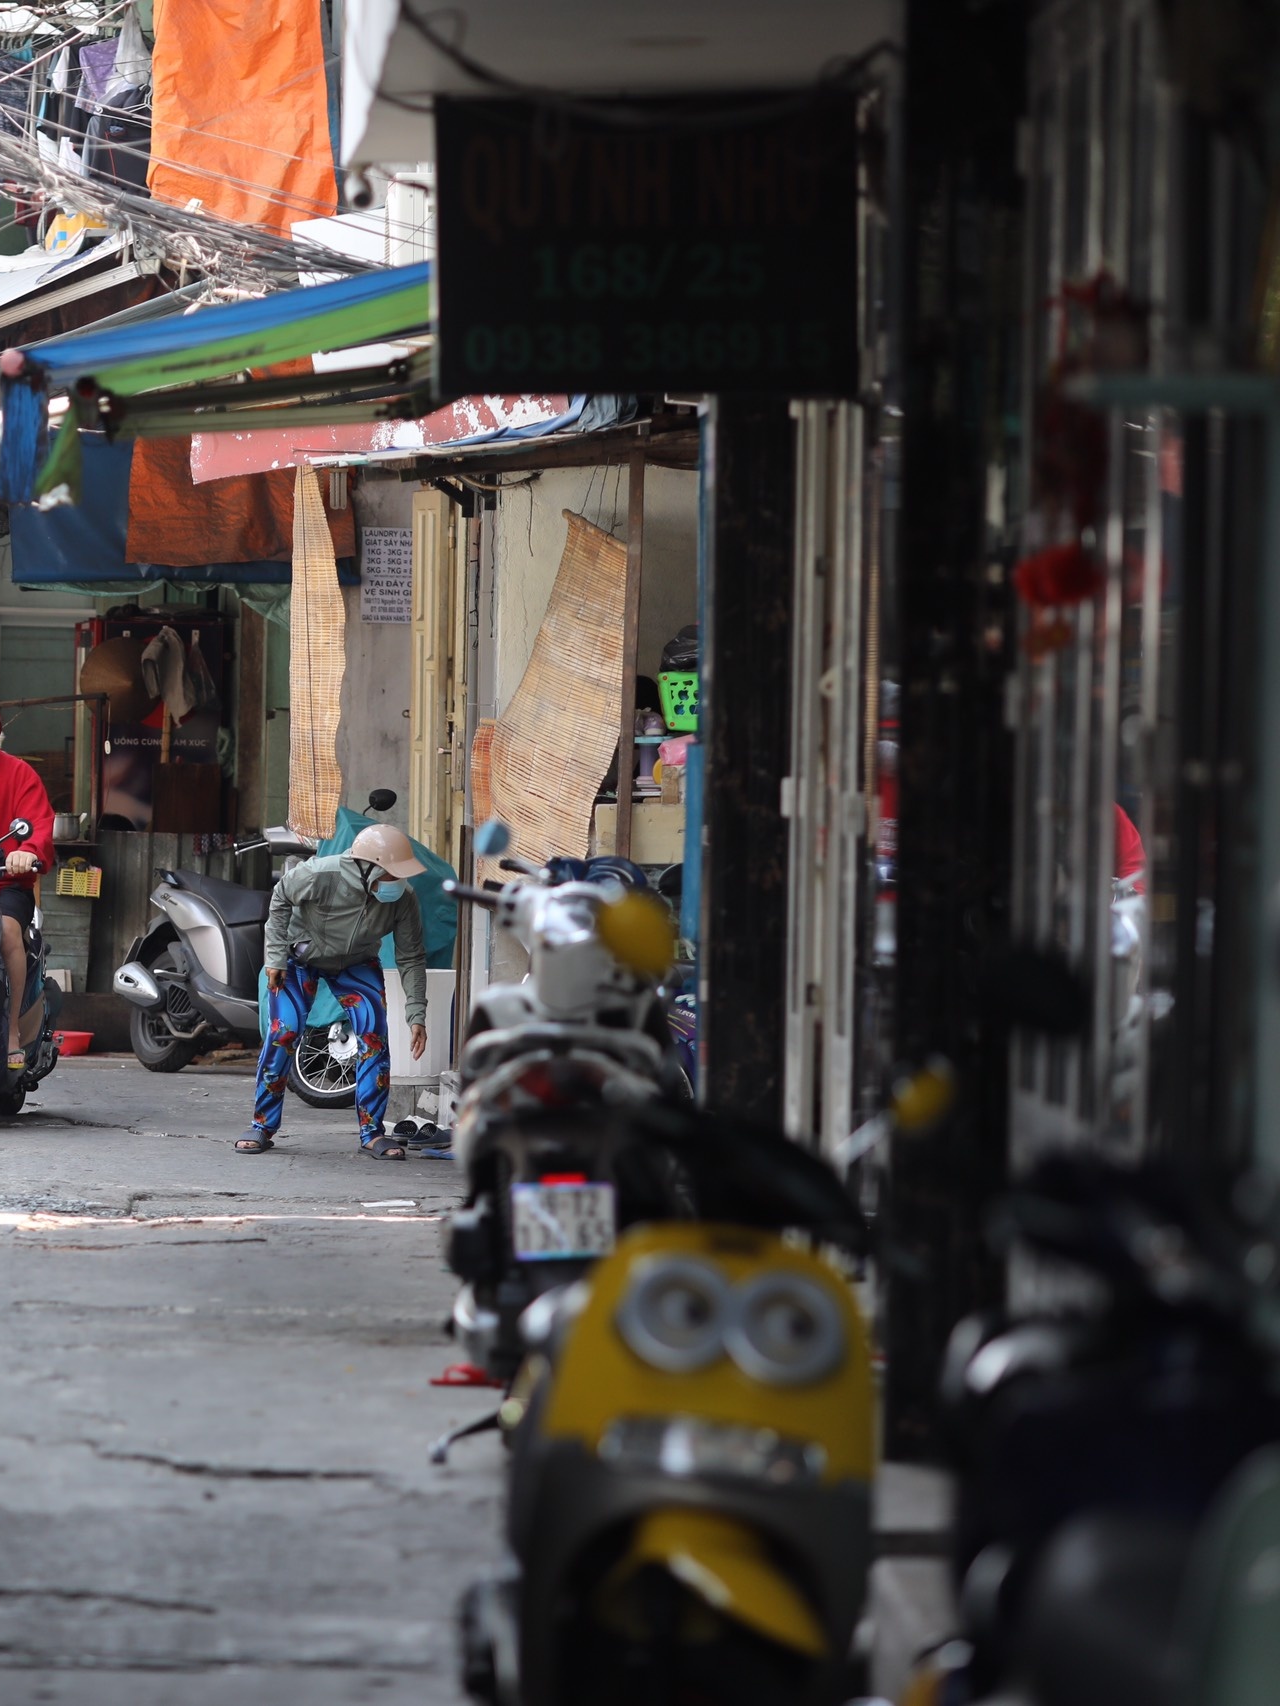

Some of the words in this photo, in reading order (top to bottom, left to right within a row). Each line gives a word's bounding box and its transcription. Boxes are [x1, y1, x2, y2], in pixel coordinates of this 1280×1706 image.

[463, 323, 602, 375] 0938
[624, 322, 830, 373] 386915
[367, 566, 381, 574] 5KG
